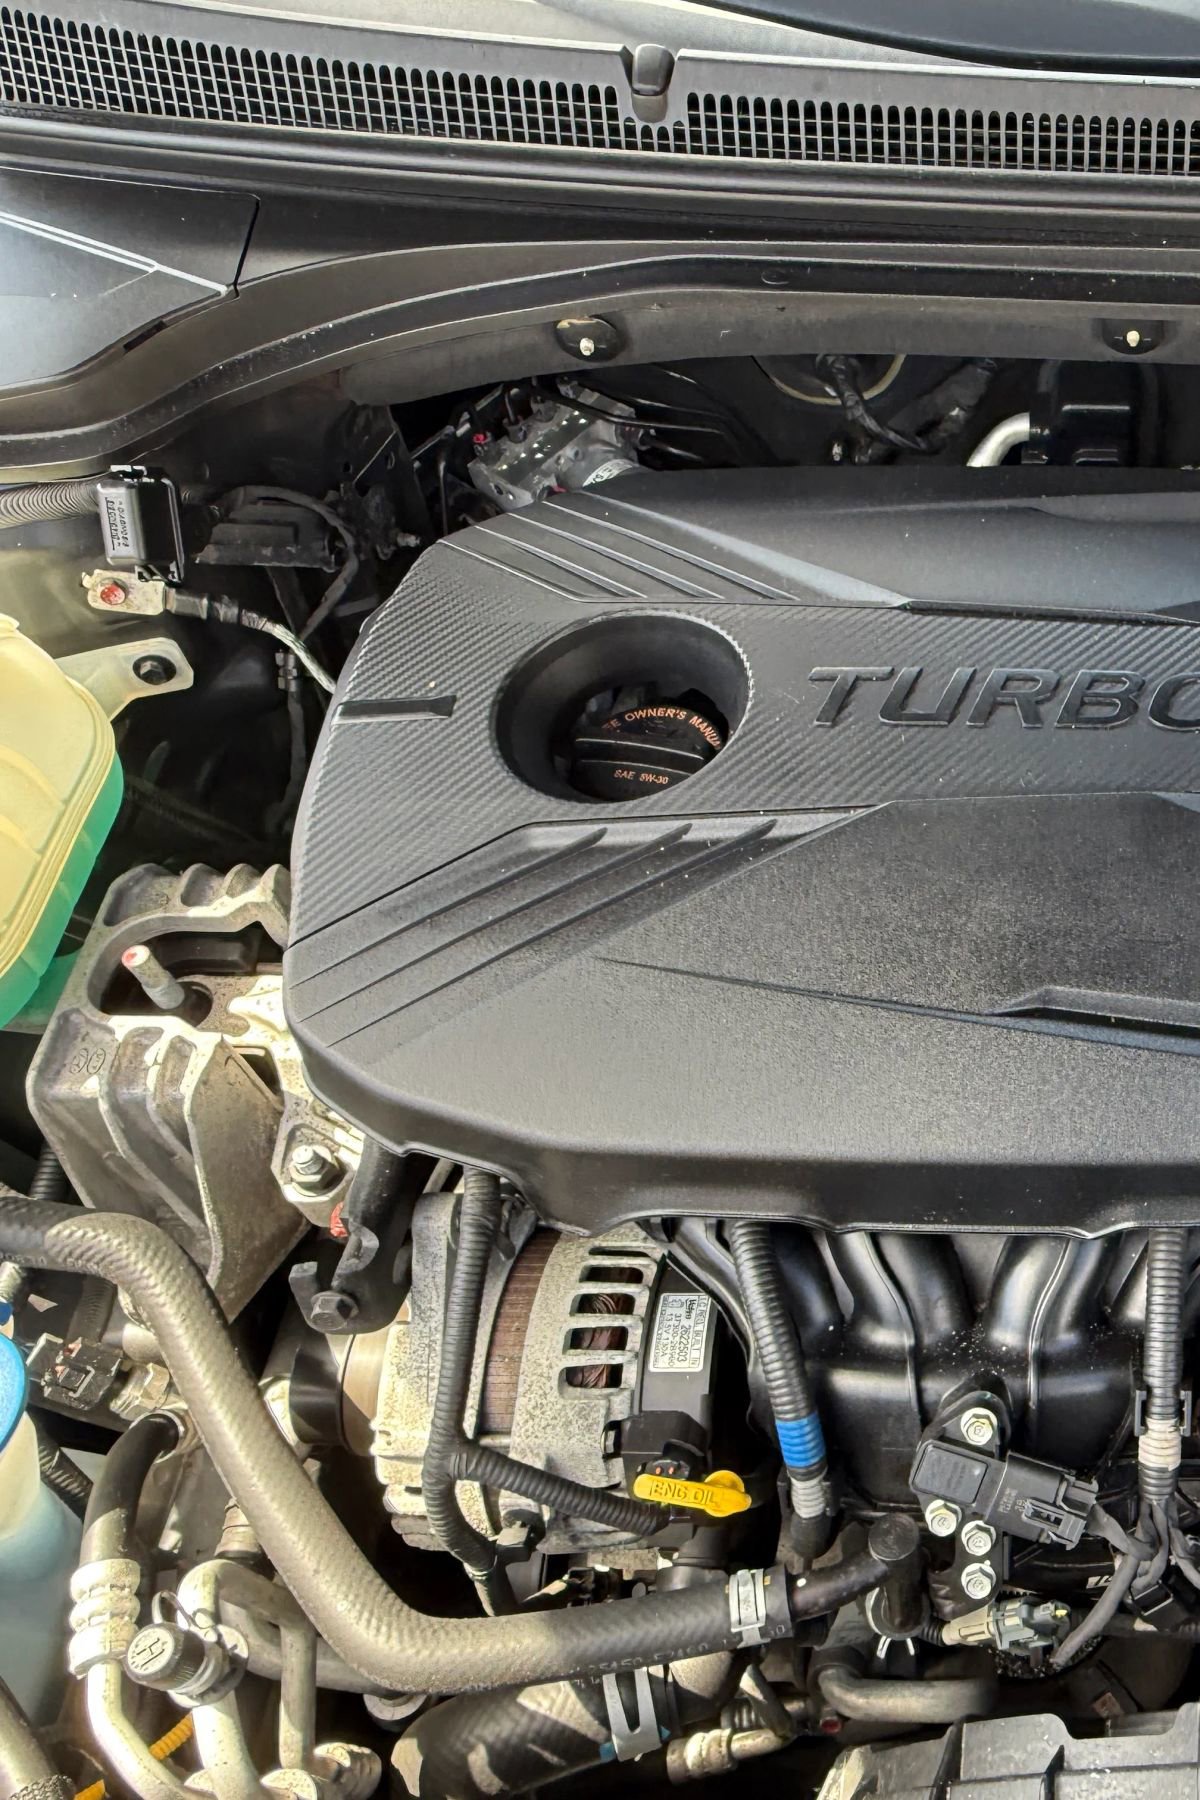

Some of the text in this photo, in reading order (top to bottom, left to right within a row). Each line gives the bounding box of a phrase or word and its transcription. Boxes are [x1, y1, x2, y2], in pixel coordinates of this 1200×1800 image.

[624, 707, 687, 722] OWNER'S
[688, 715, 722, 750] MANUA
[613, 769, 670, 785] SAE 5W-30
[649, 1479, 719, 1507] ENG OIL
